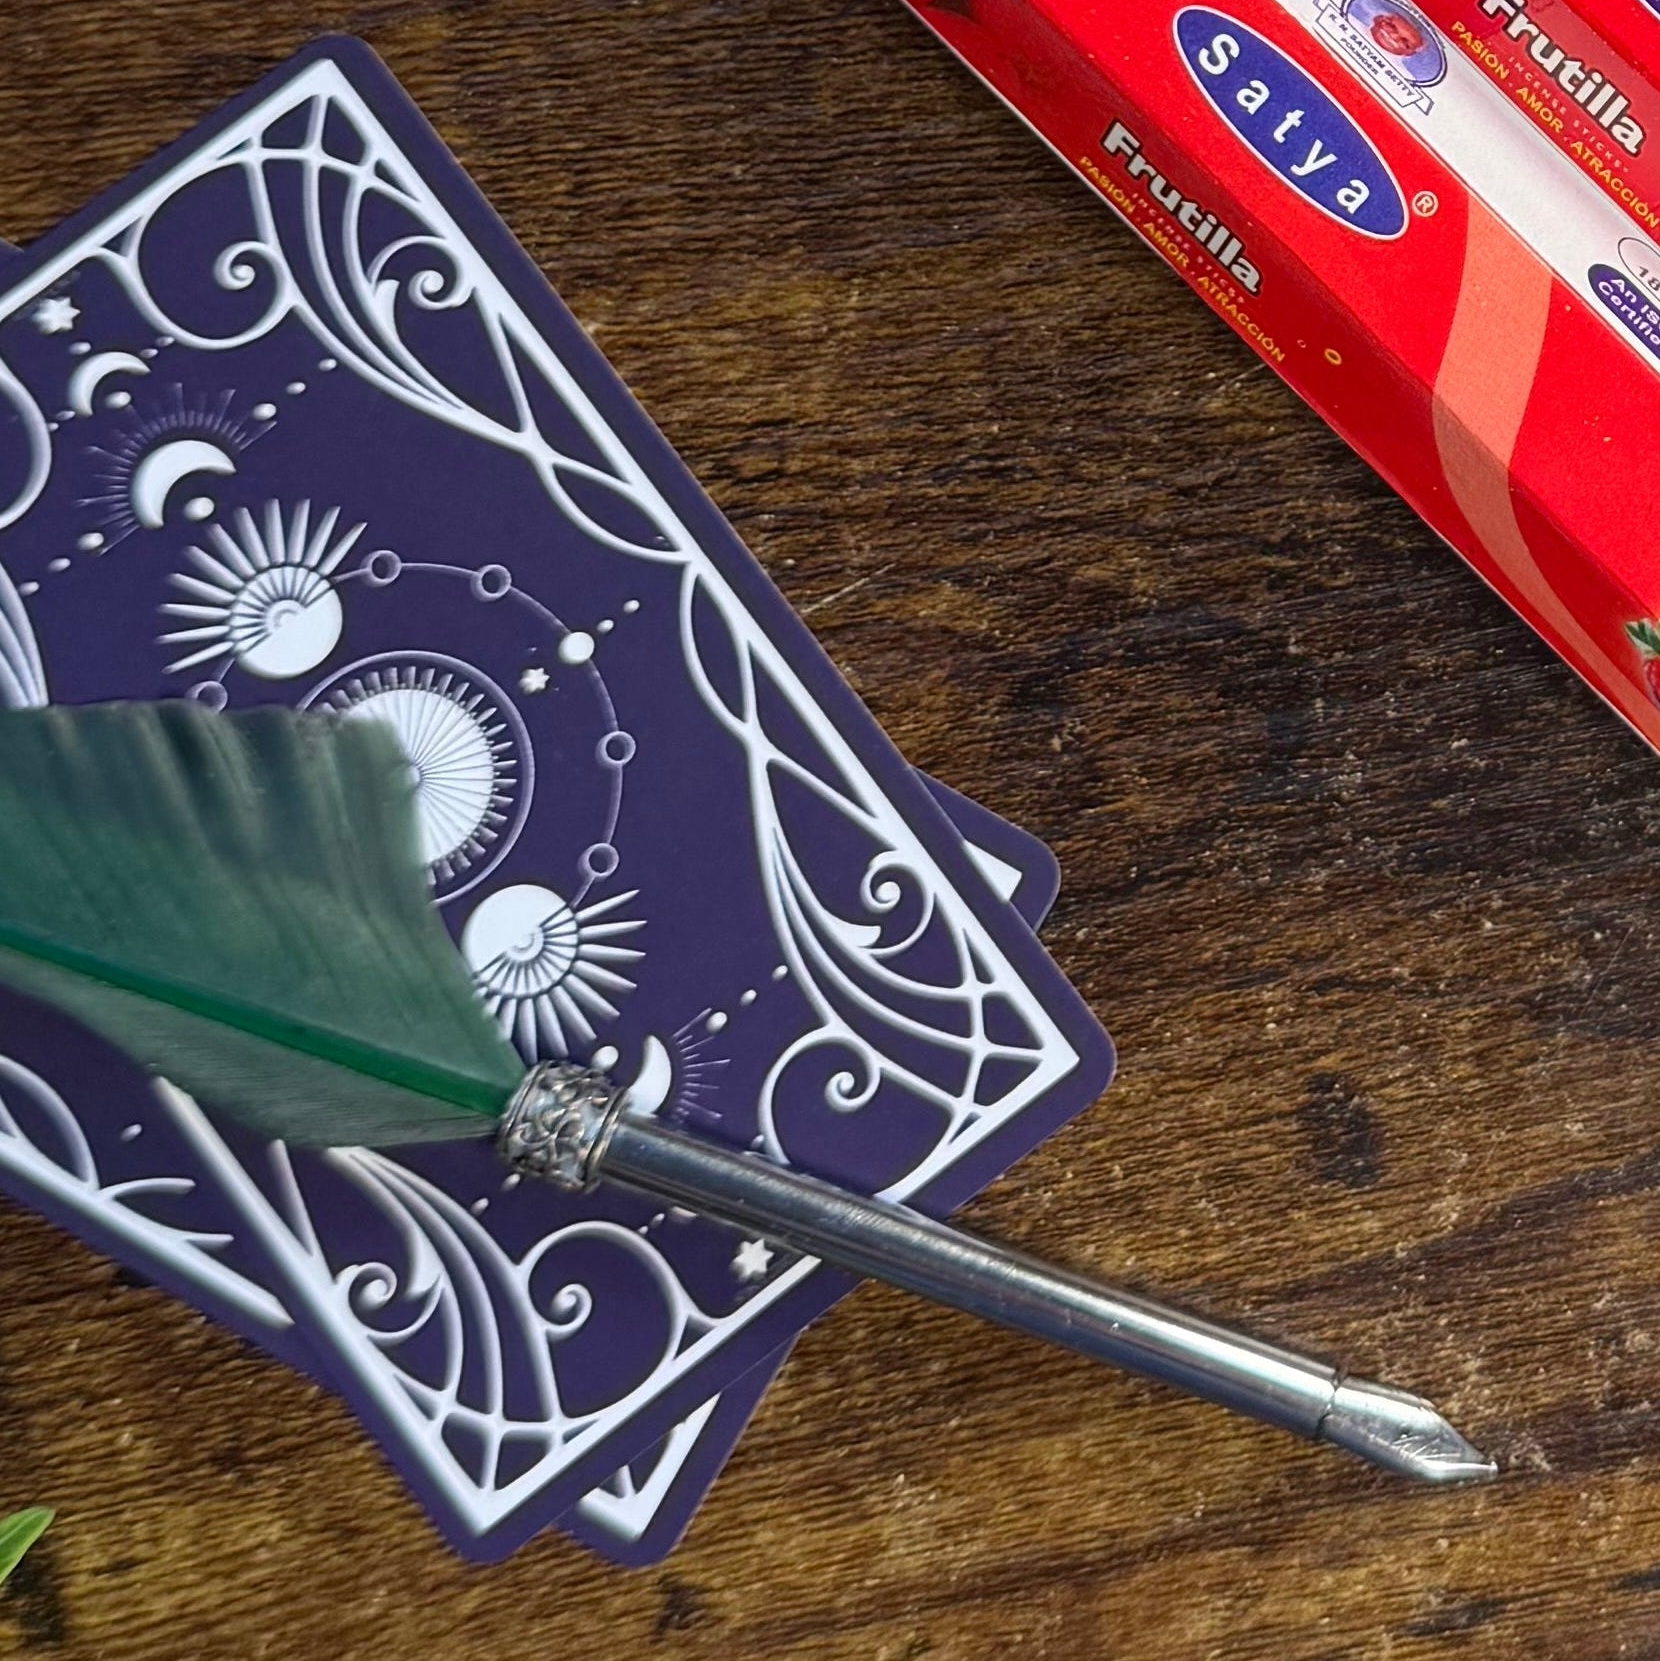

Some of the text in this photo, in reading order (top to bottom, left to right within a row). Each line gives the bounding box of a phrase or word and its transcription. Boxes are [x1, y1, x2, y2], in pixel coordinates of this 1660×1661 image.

[1198, 33, 1370, 215] Satya
[1452, 21, 1659, 227] PASIÓN AMOR ATRACCIÓN
[1508, 56, 1566, 114] INCENSE
[1079, 156, 1284, 361] PASIÓN AMOR ATRACCIÓN
[1102, 122, 1258, 292] Frutilla
[1610, 278, 1637, 303] An
